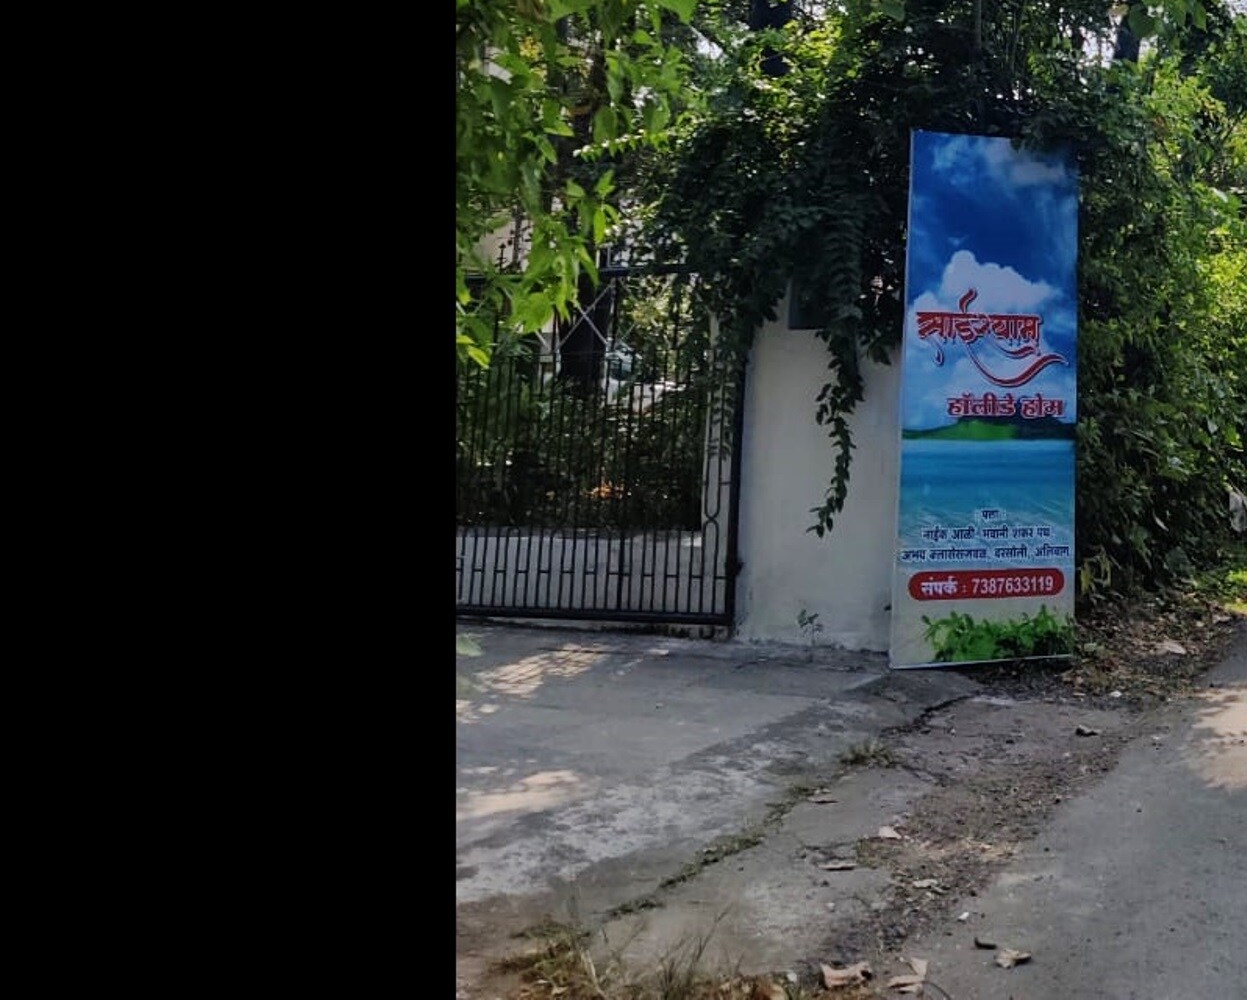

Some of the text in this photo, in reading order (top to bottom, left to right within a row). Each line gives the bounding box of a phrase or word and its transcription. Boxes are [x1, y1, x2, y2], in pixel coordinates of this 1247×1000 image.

[947, 392, 1064, 418] हॉलीडे होम
[920, 576, 958, 596] संपर्क
[972, 576, 1054, 594] 7387633119
